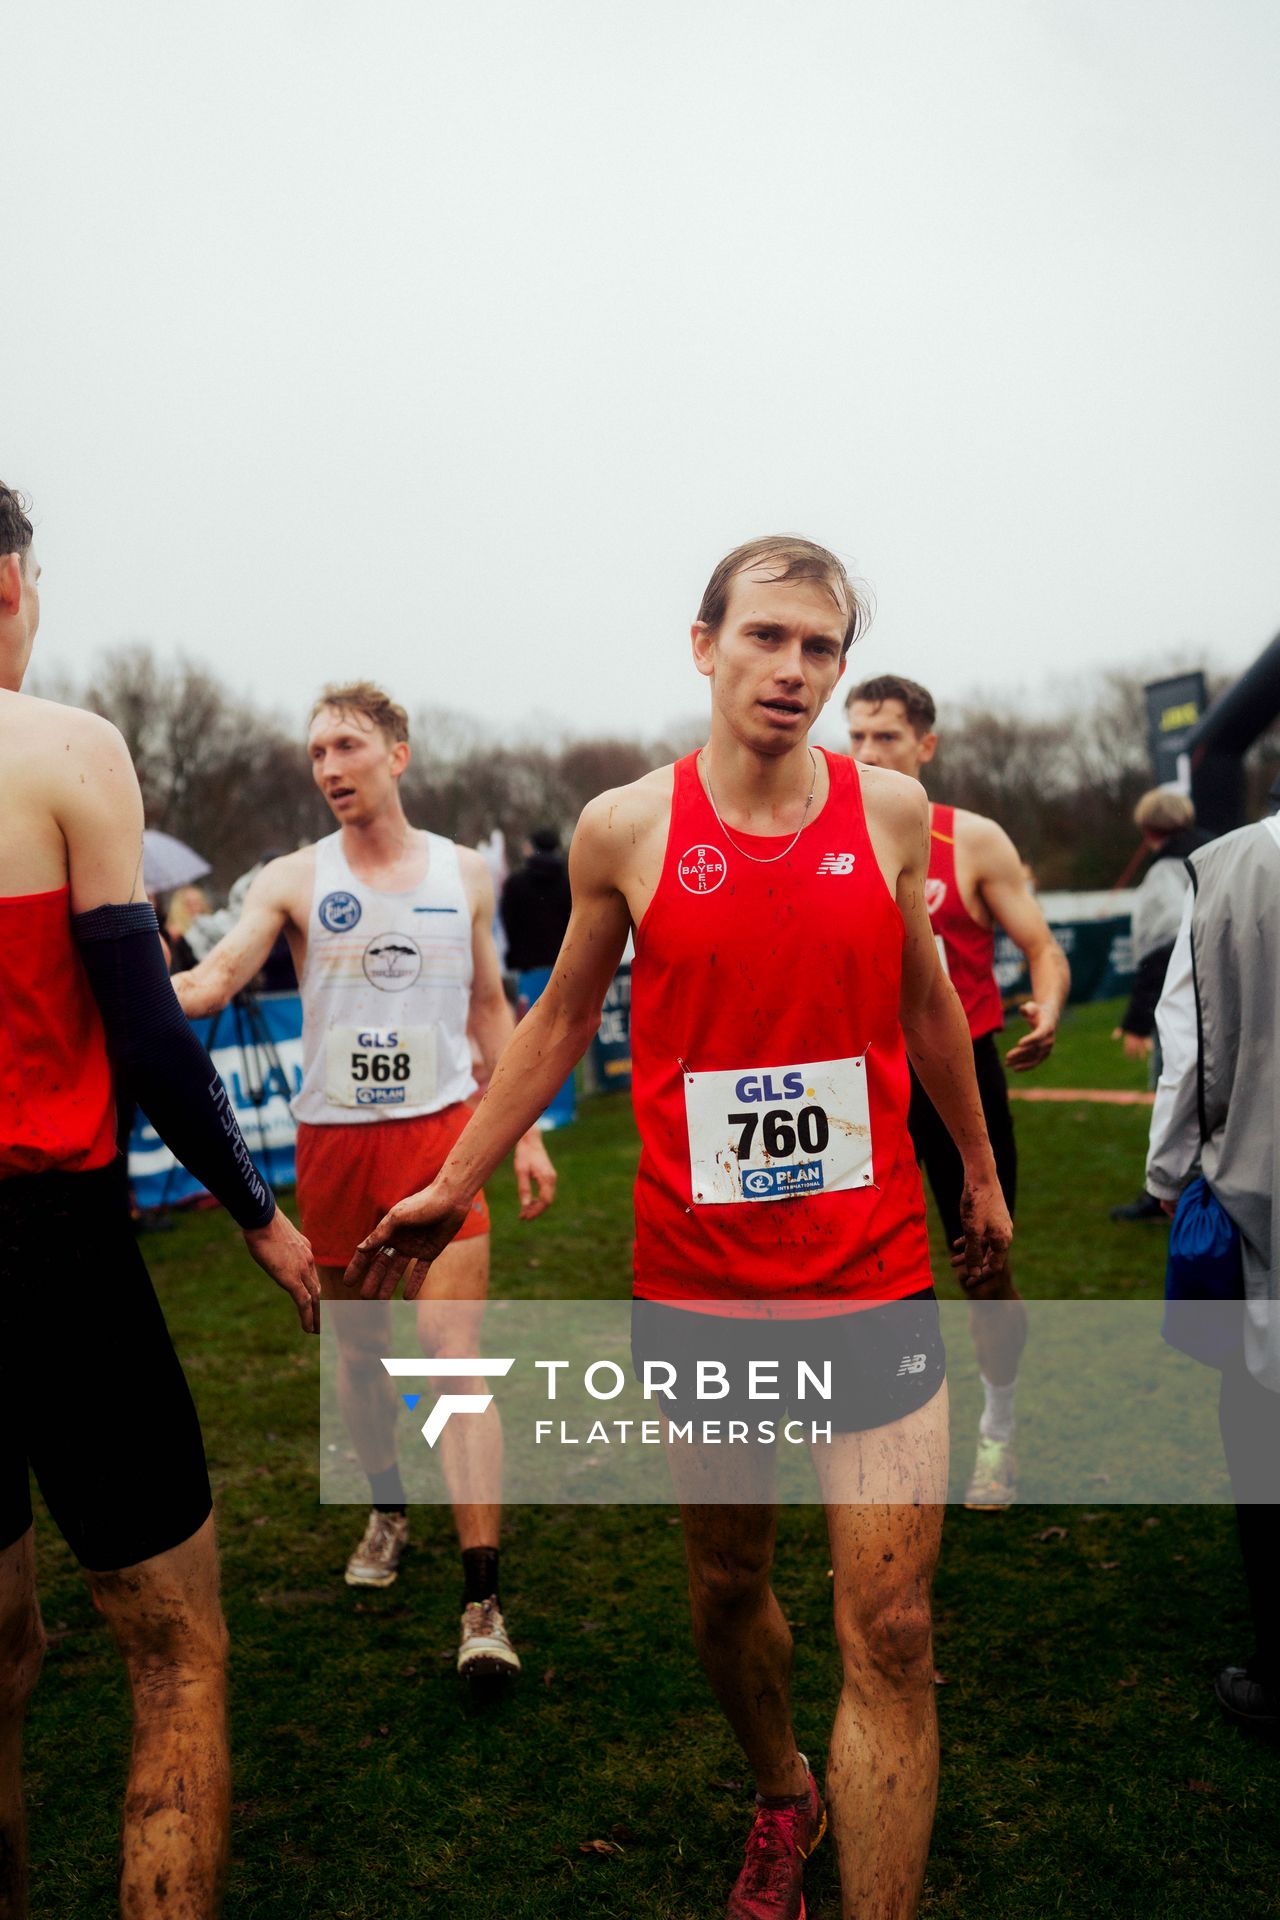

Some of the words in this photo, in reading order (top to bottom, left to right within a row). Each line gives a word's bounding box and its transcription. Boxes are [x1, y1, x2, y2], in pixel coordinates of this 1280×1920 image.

[682, 863, 722, 875] BAYER
[697, 849, 707, 890] BAYER
[351, 1053, 411, 1082] 568
[728, 1105, 829, 1160] 760
[776, 1166, 820, 1185] PLAN
